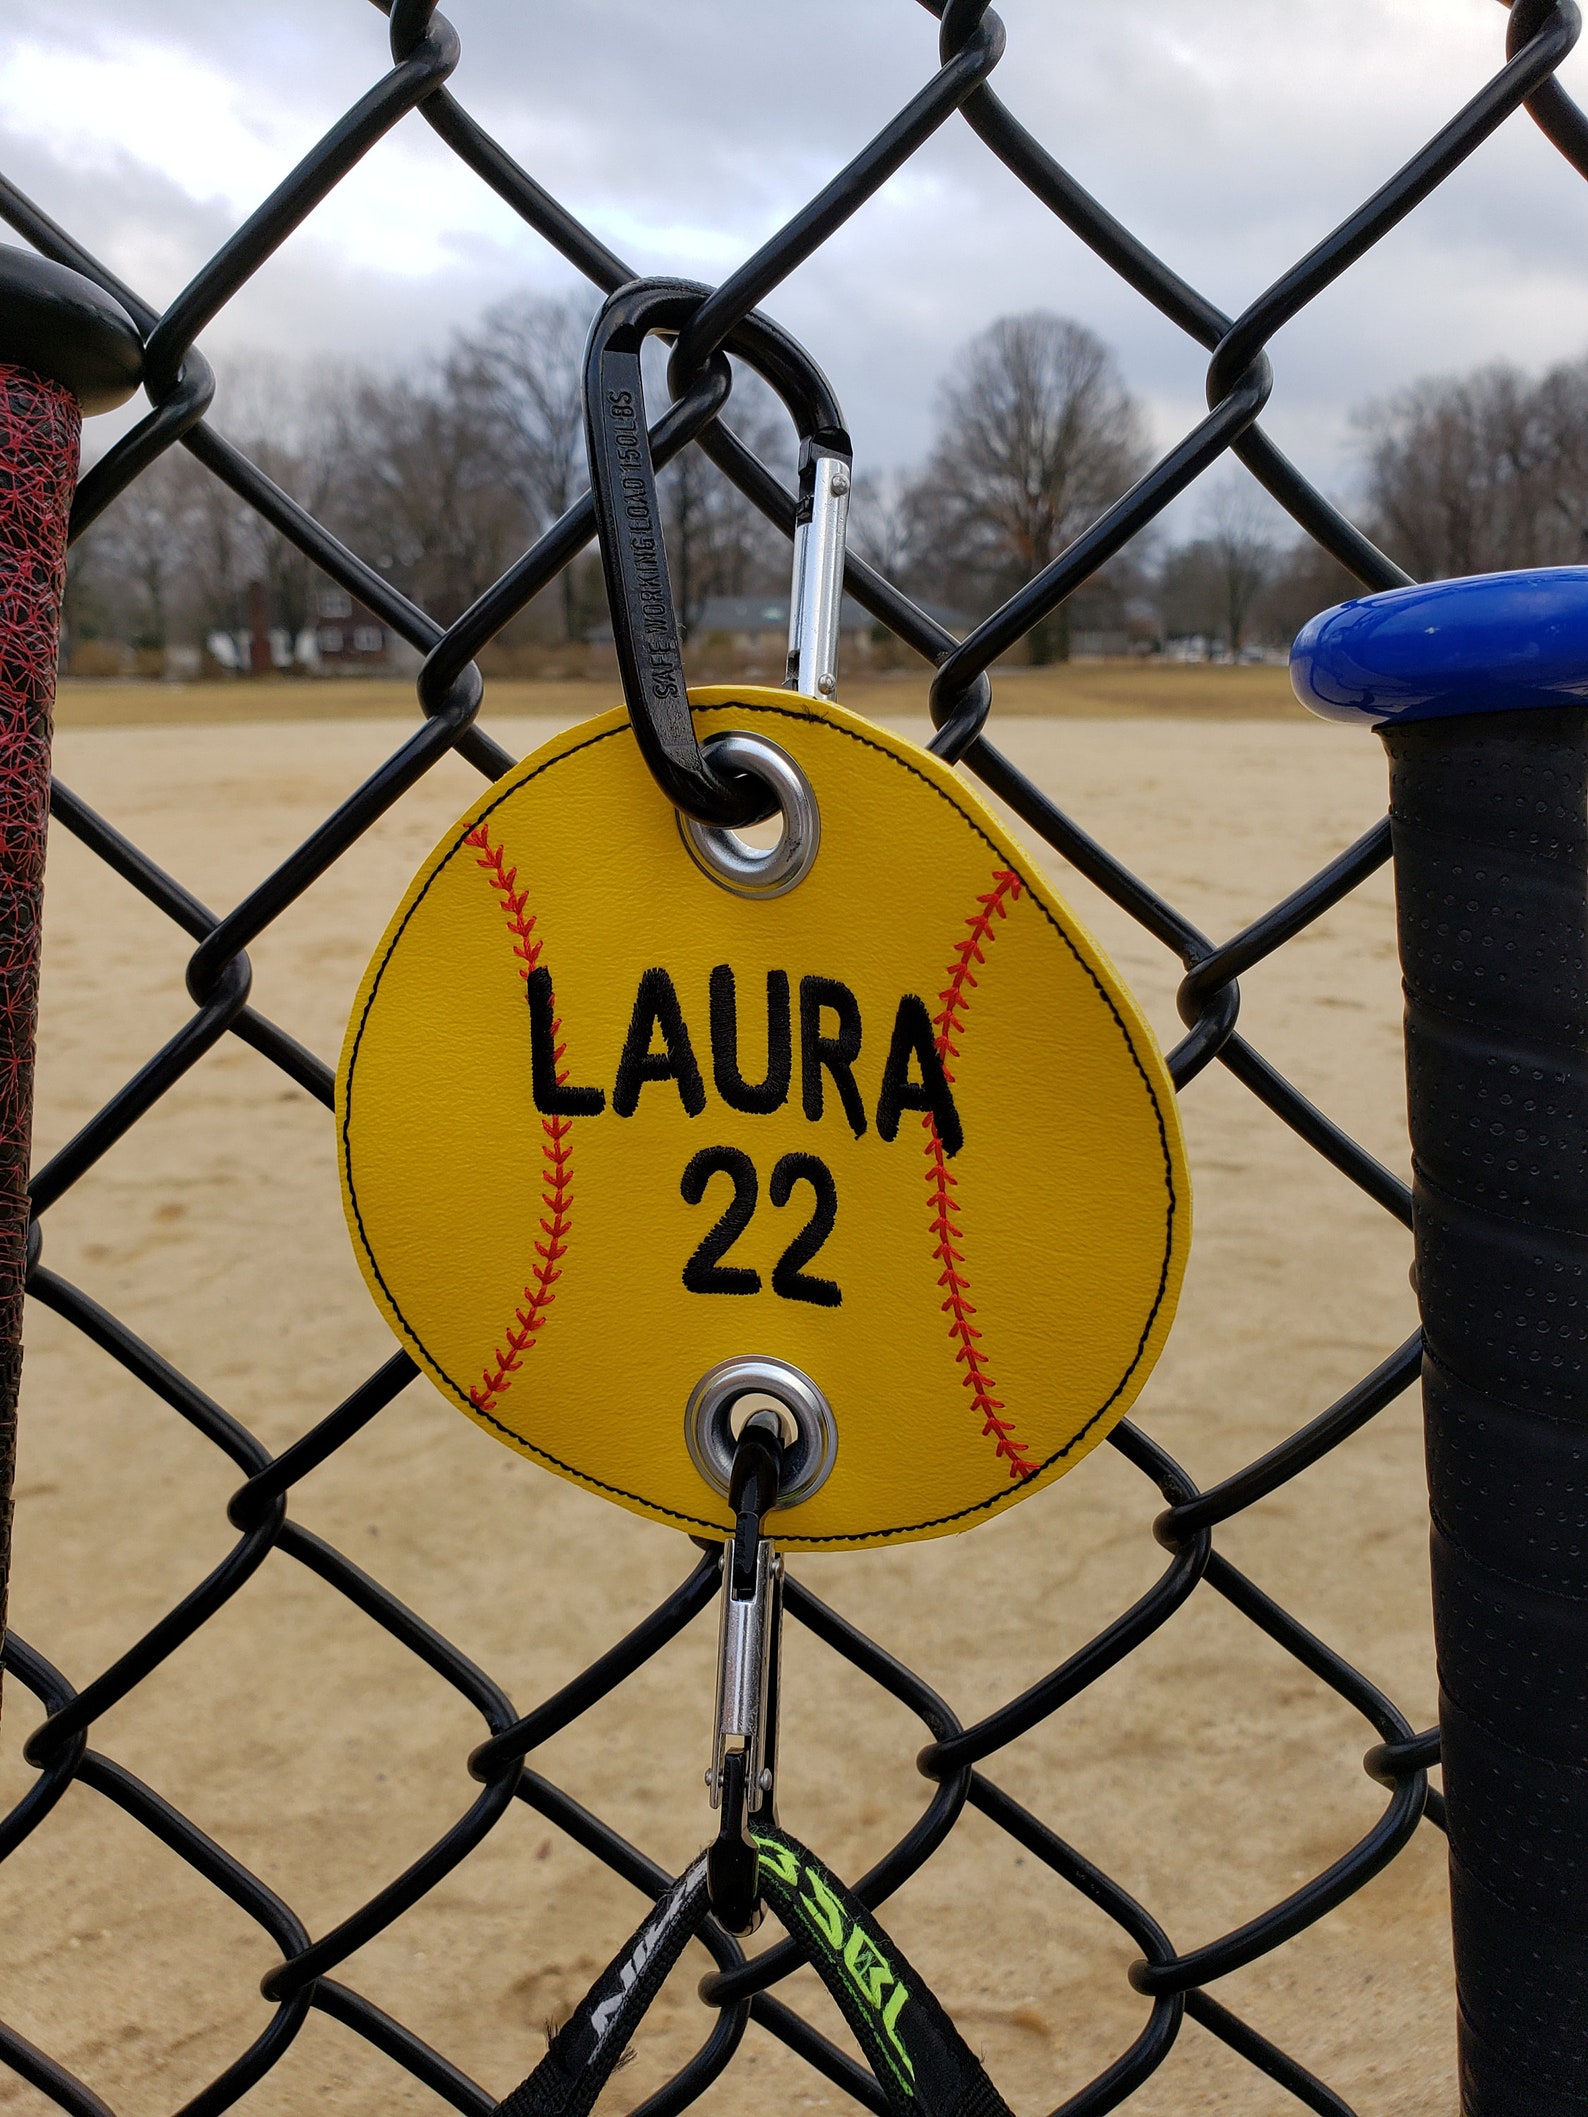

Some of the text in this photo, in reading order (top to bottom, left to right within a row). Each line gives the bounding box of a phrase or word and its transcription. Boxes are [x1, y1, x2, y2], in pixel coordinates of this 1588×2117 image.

[621, 477, 654, 535] LOAD
[631, 536, 668, 635] WORKING
[649, 640, 679, 699] SAFE
[526, 962, 964, 1159] LAURA
[680, 1145, 843, 1308] 22
